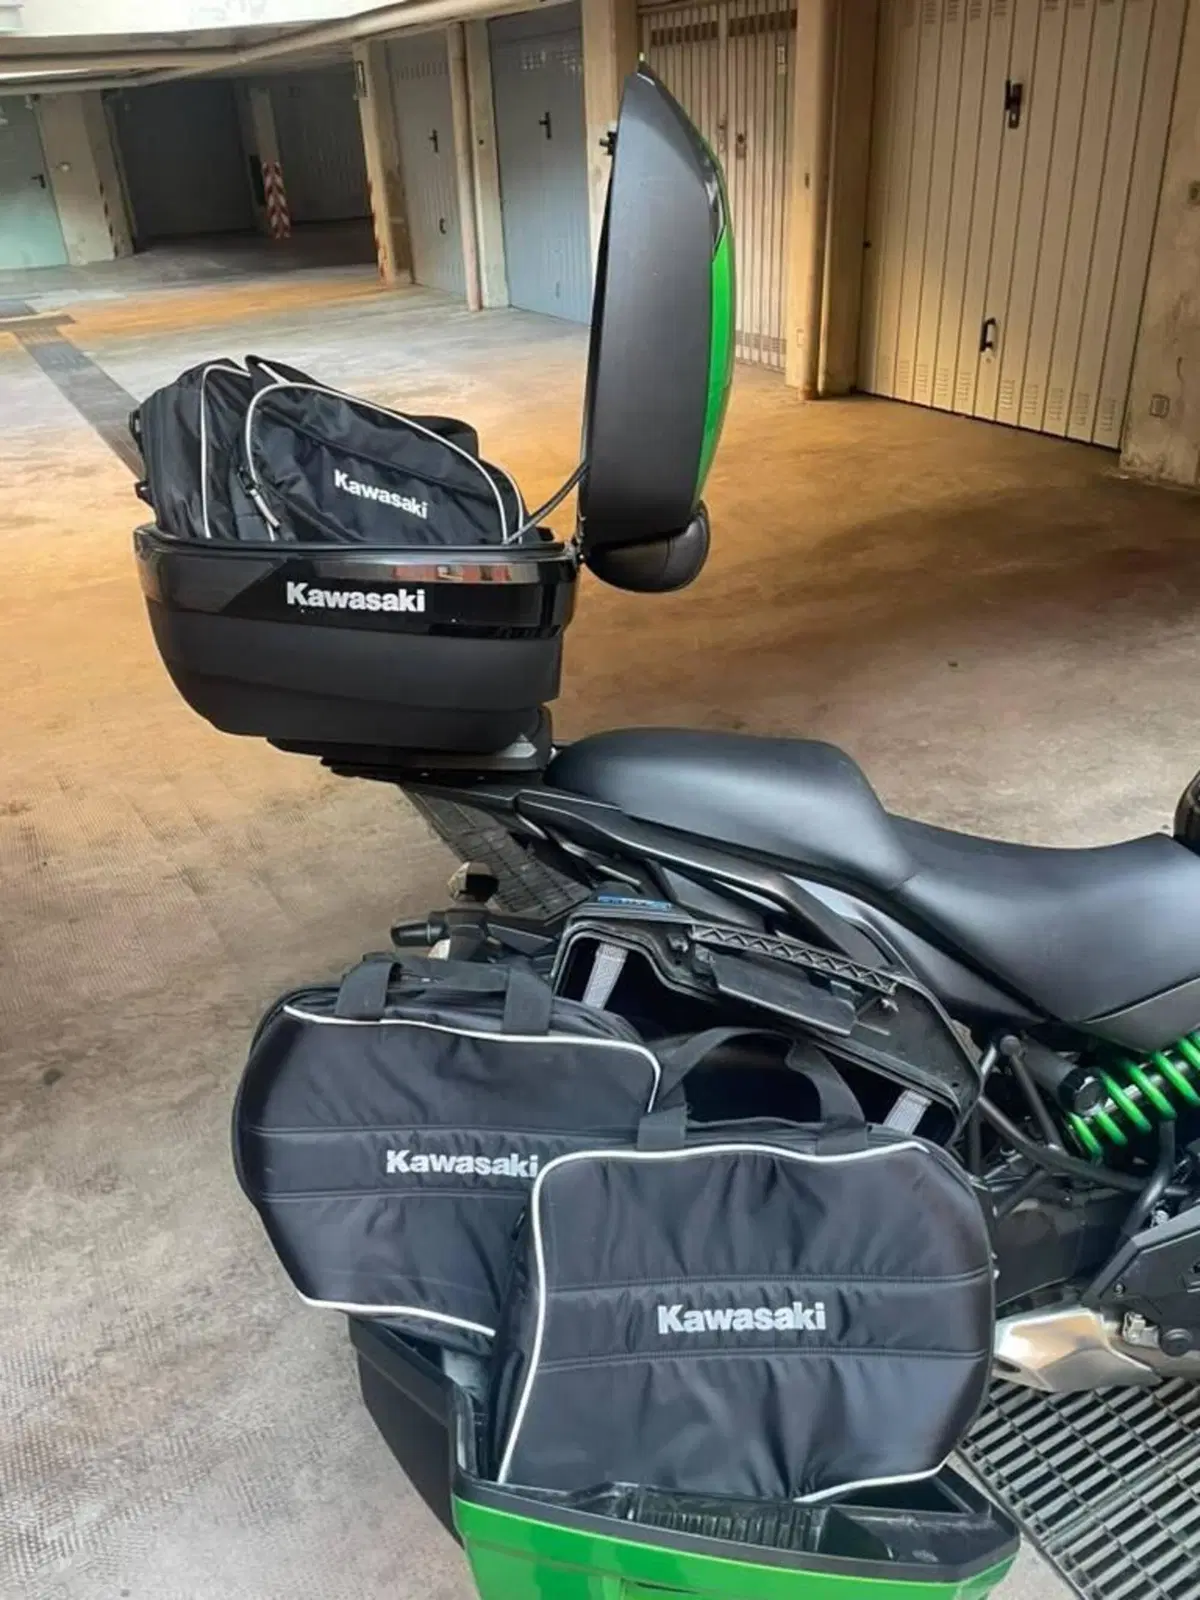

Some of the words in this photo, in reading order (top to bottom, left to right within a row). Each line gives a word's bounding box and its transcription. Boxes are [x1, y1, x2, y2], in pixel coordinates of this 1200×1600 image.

[334, 468, 428, 520] Kawasaki
[286, 581, 426, 612] Kawasaki
[386, 1150, 538, 1178] Kawasaki
[657, 1301, 826, 1335] Kawasaki
